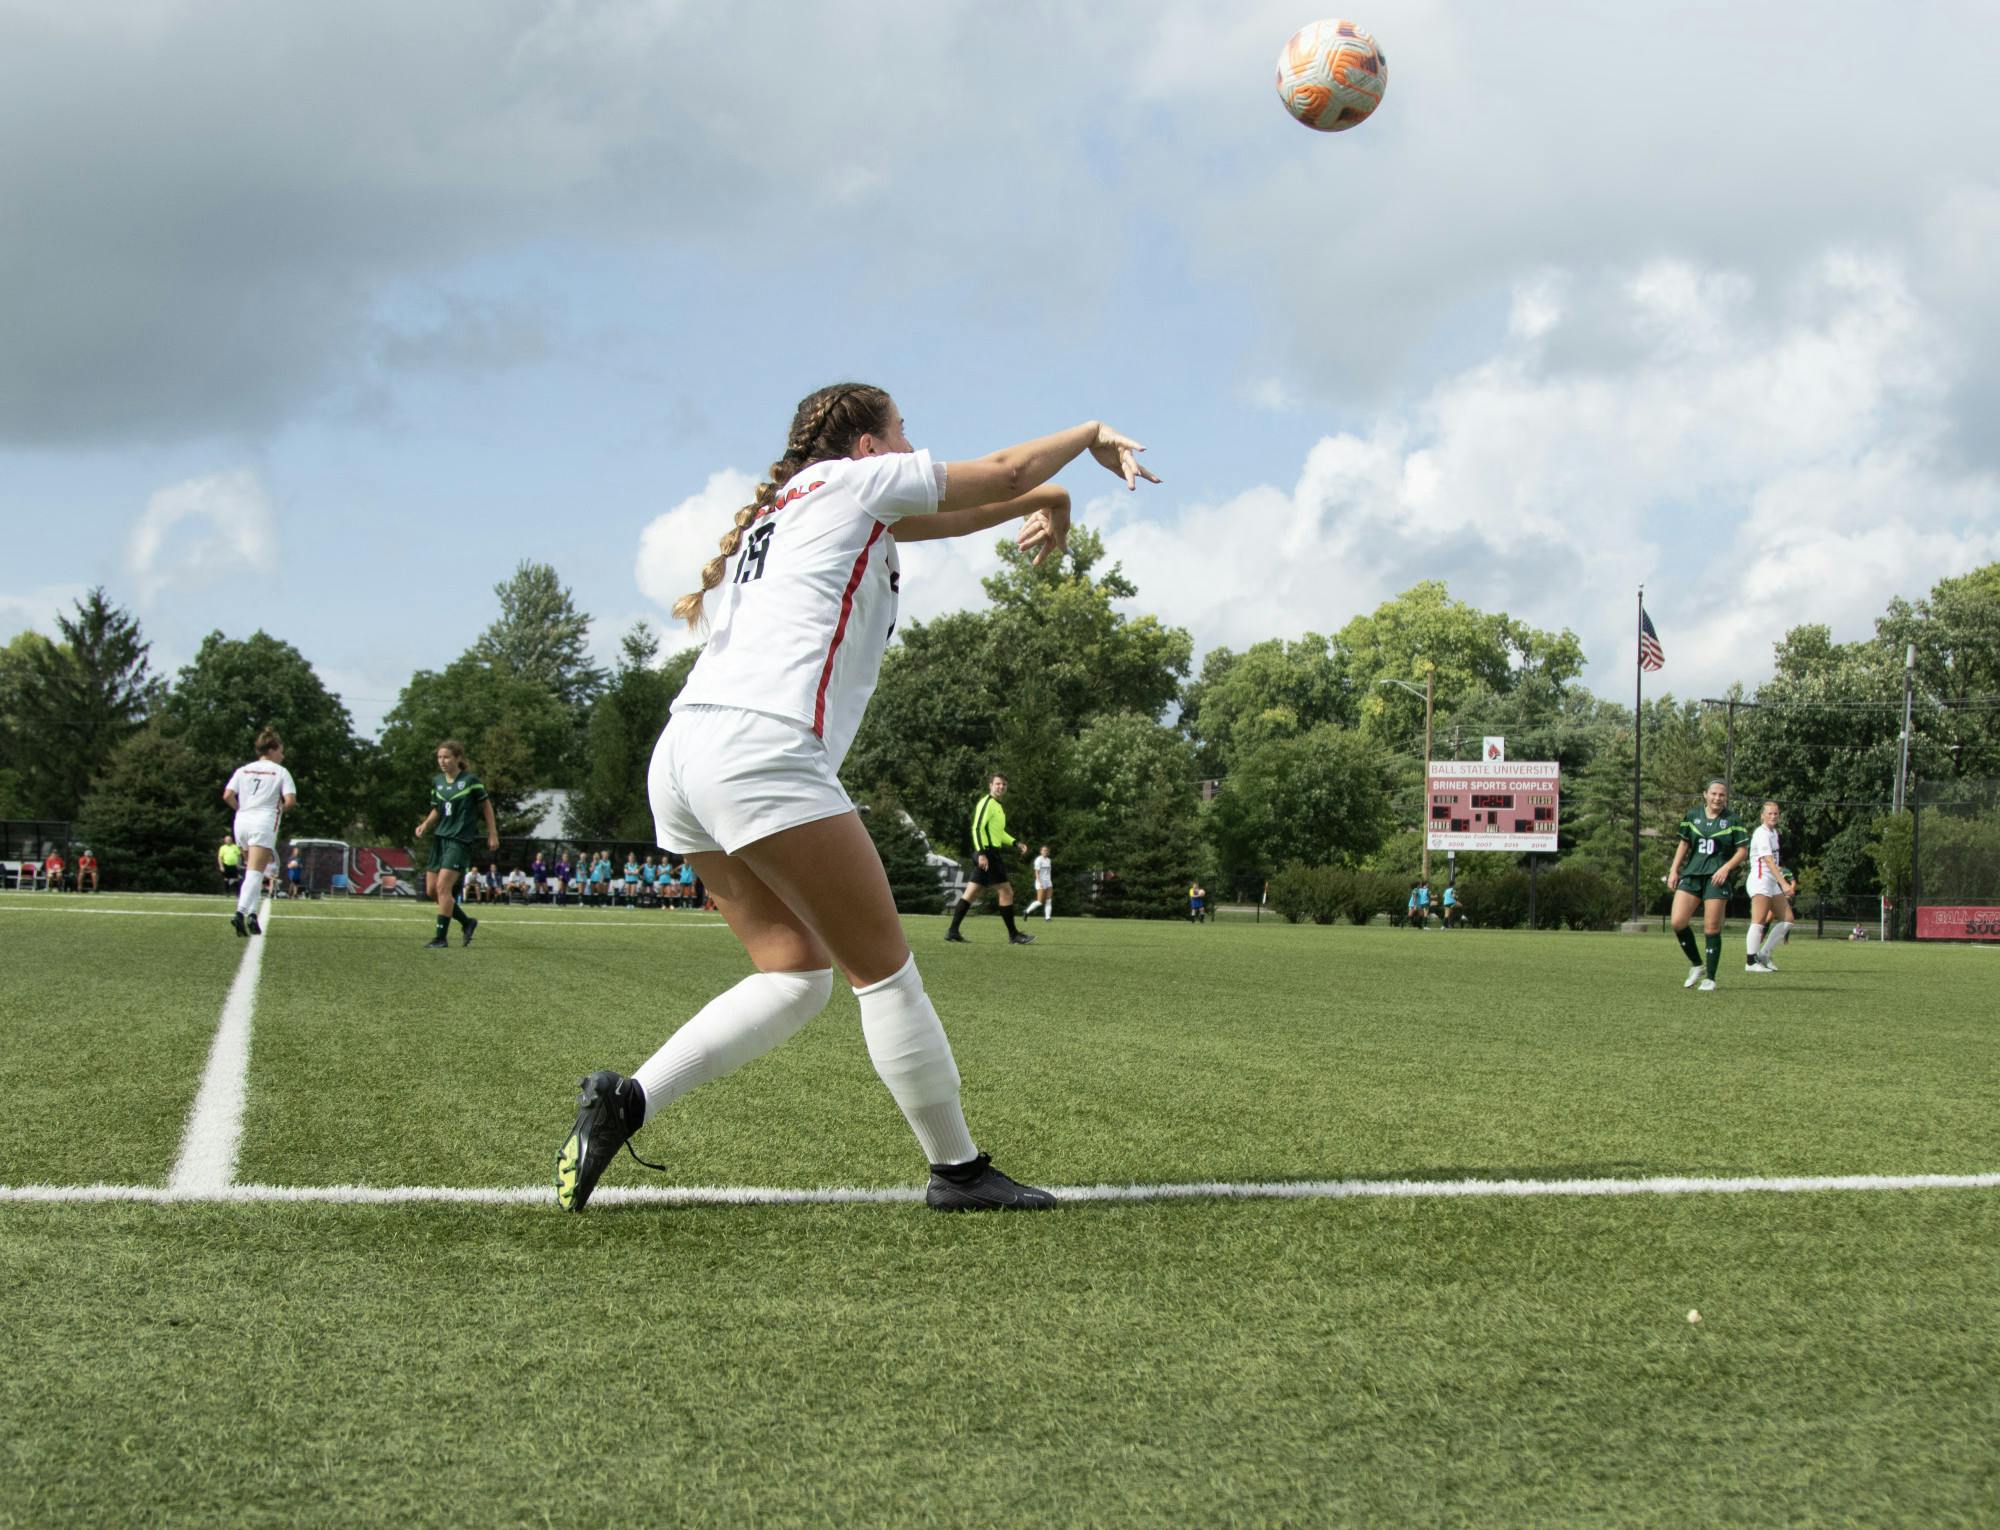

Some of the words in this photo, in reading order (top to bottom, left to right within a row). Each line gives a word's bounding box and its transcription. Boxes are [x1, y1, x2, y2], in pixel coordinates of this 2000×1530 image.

[1431, 765, 1457, 774] BALL
[1460, 765, 1490, 774] STATE
[1494, 765, 1556, 775] UNIVERSITY
[253, 778, 261, 795] 7
[1433, 781, 1468, 790] BRINER
[1471, 781, 1507, 790] SPORTS
[1509, 781, 1553, 791] COMPLEX
[1698, 838, 1714, 854] 20
[1936, 910, 1968, 924] BALL
